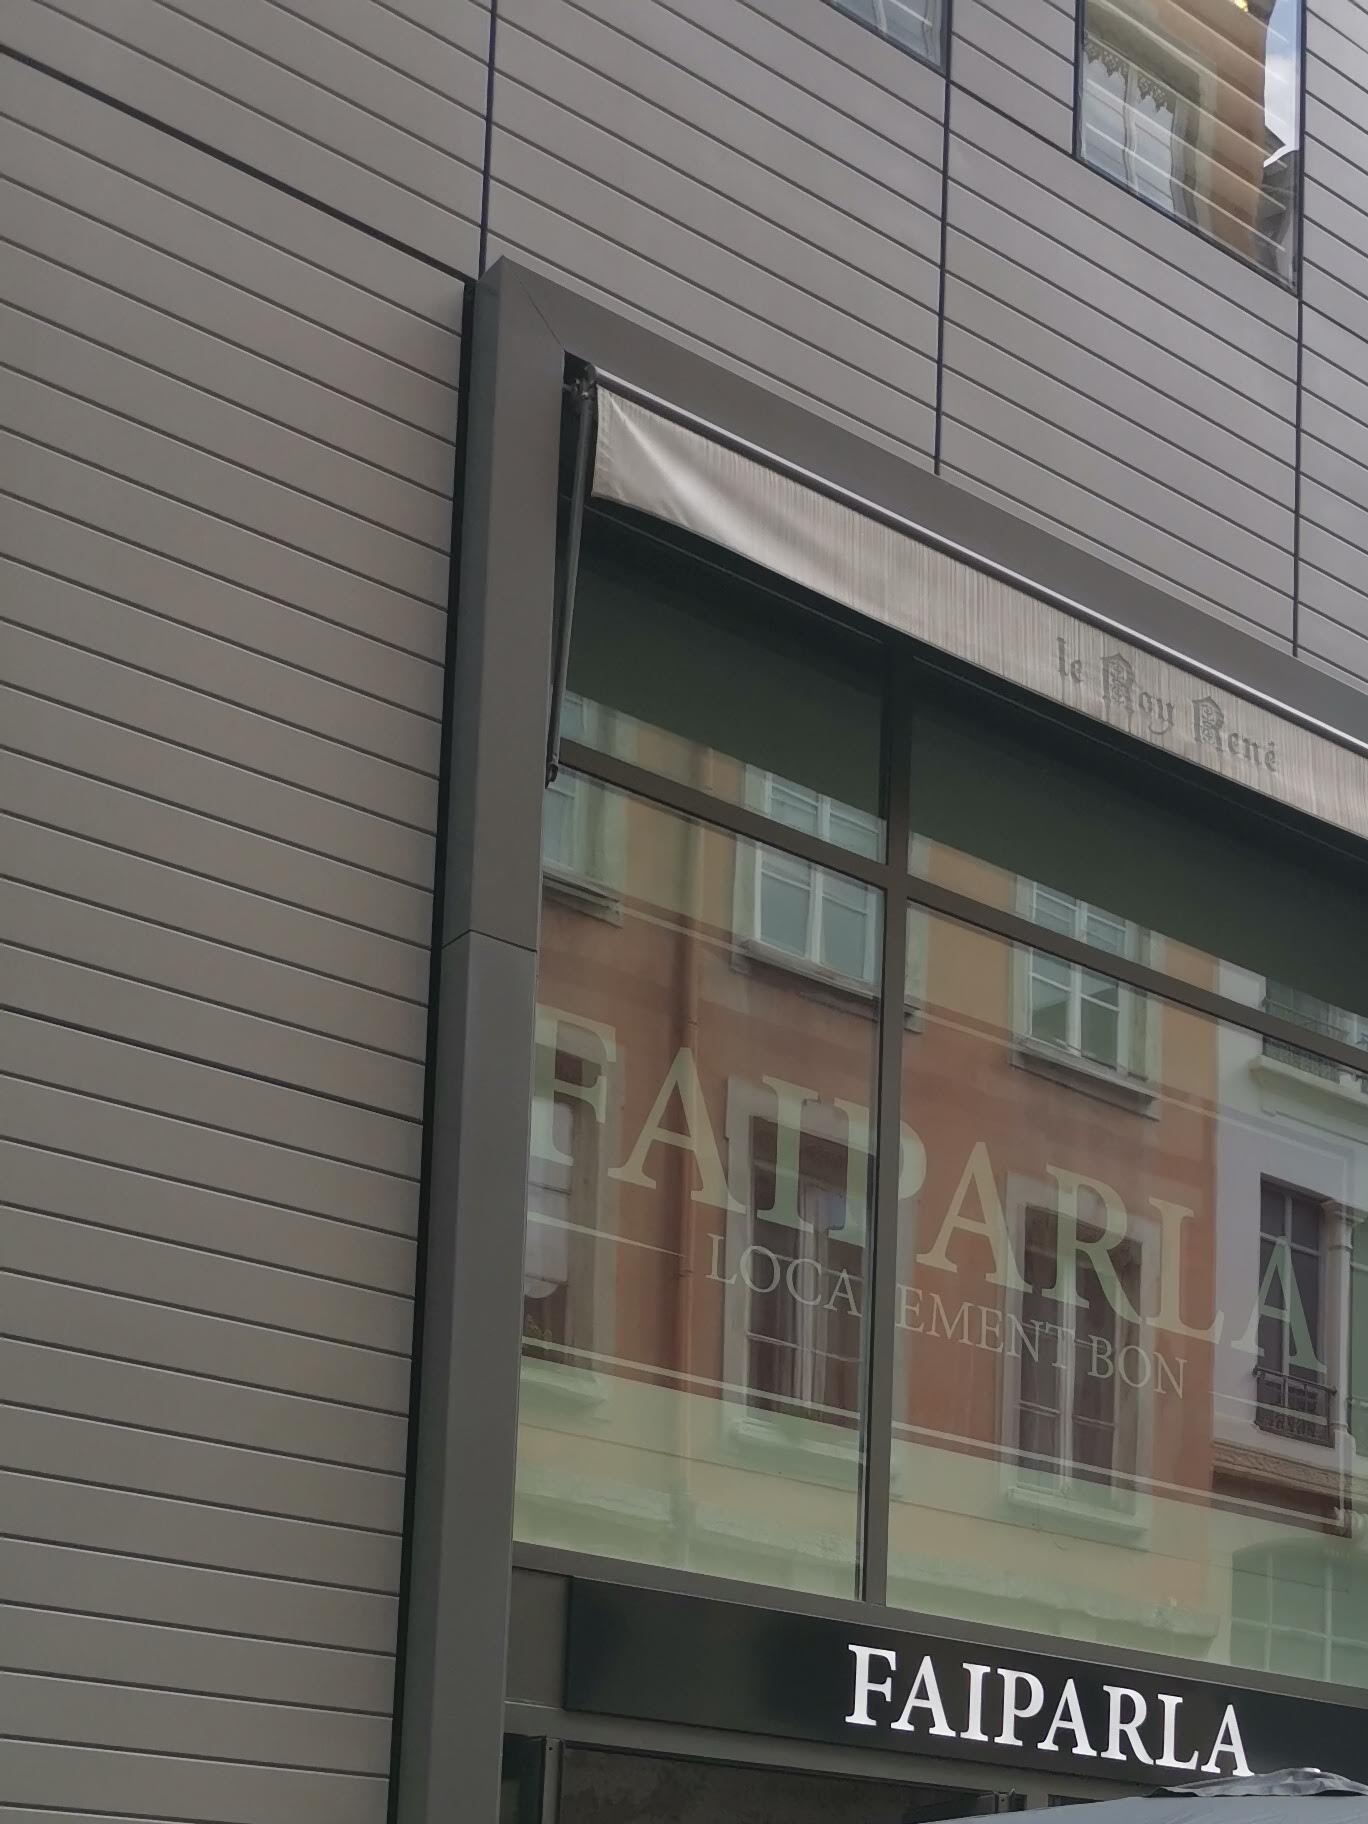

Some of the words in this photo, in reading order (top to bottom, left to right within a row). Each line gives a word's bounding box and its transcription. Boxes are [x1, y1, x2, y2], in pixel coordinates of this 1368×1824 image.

[1056, 637, 1082, 684] le
[1100, 653, 1175, 735] Roy
[1192, 696, 1278, 773] René
[530, 1002, 1326, 1374] FAIPARLA
[705, 1233, 1077, 1369] LOCAEMENT
[1087, 1334, 1187, 1400] BON
[845, 1643, 1255, 1777] FAIPARLA
